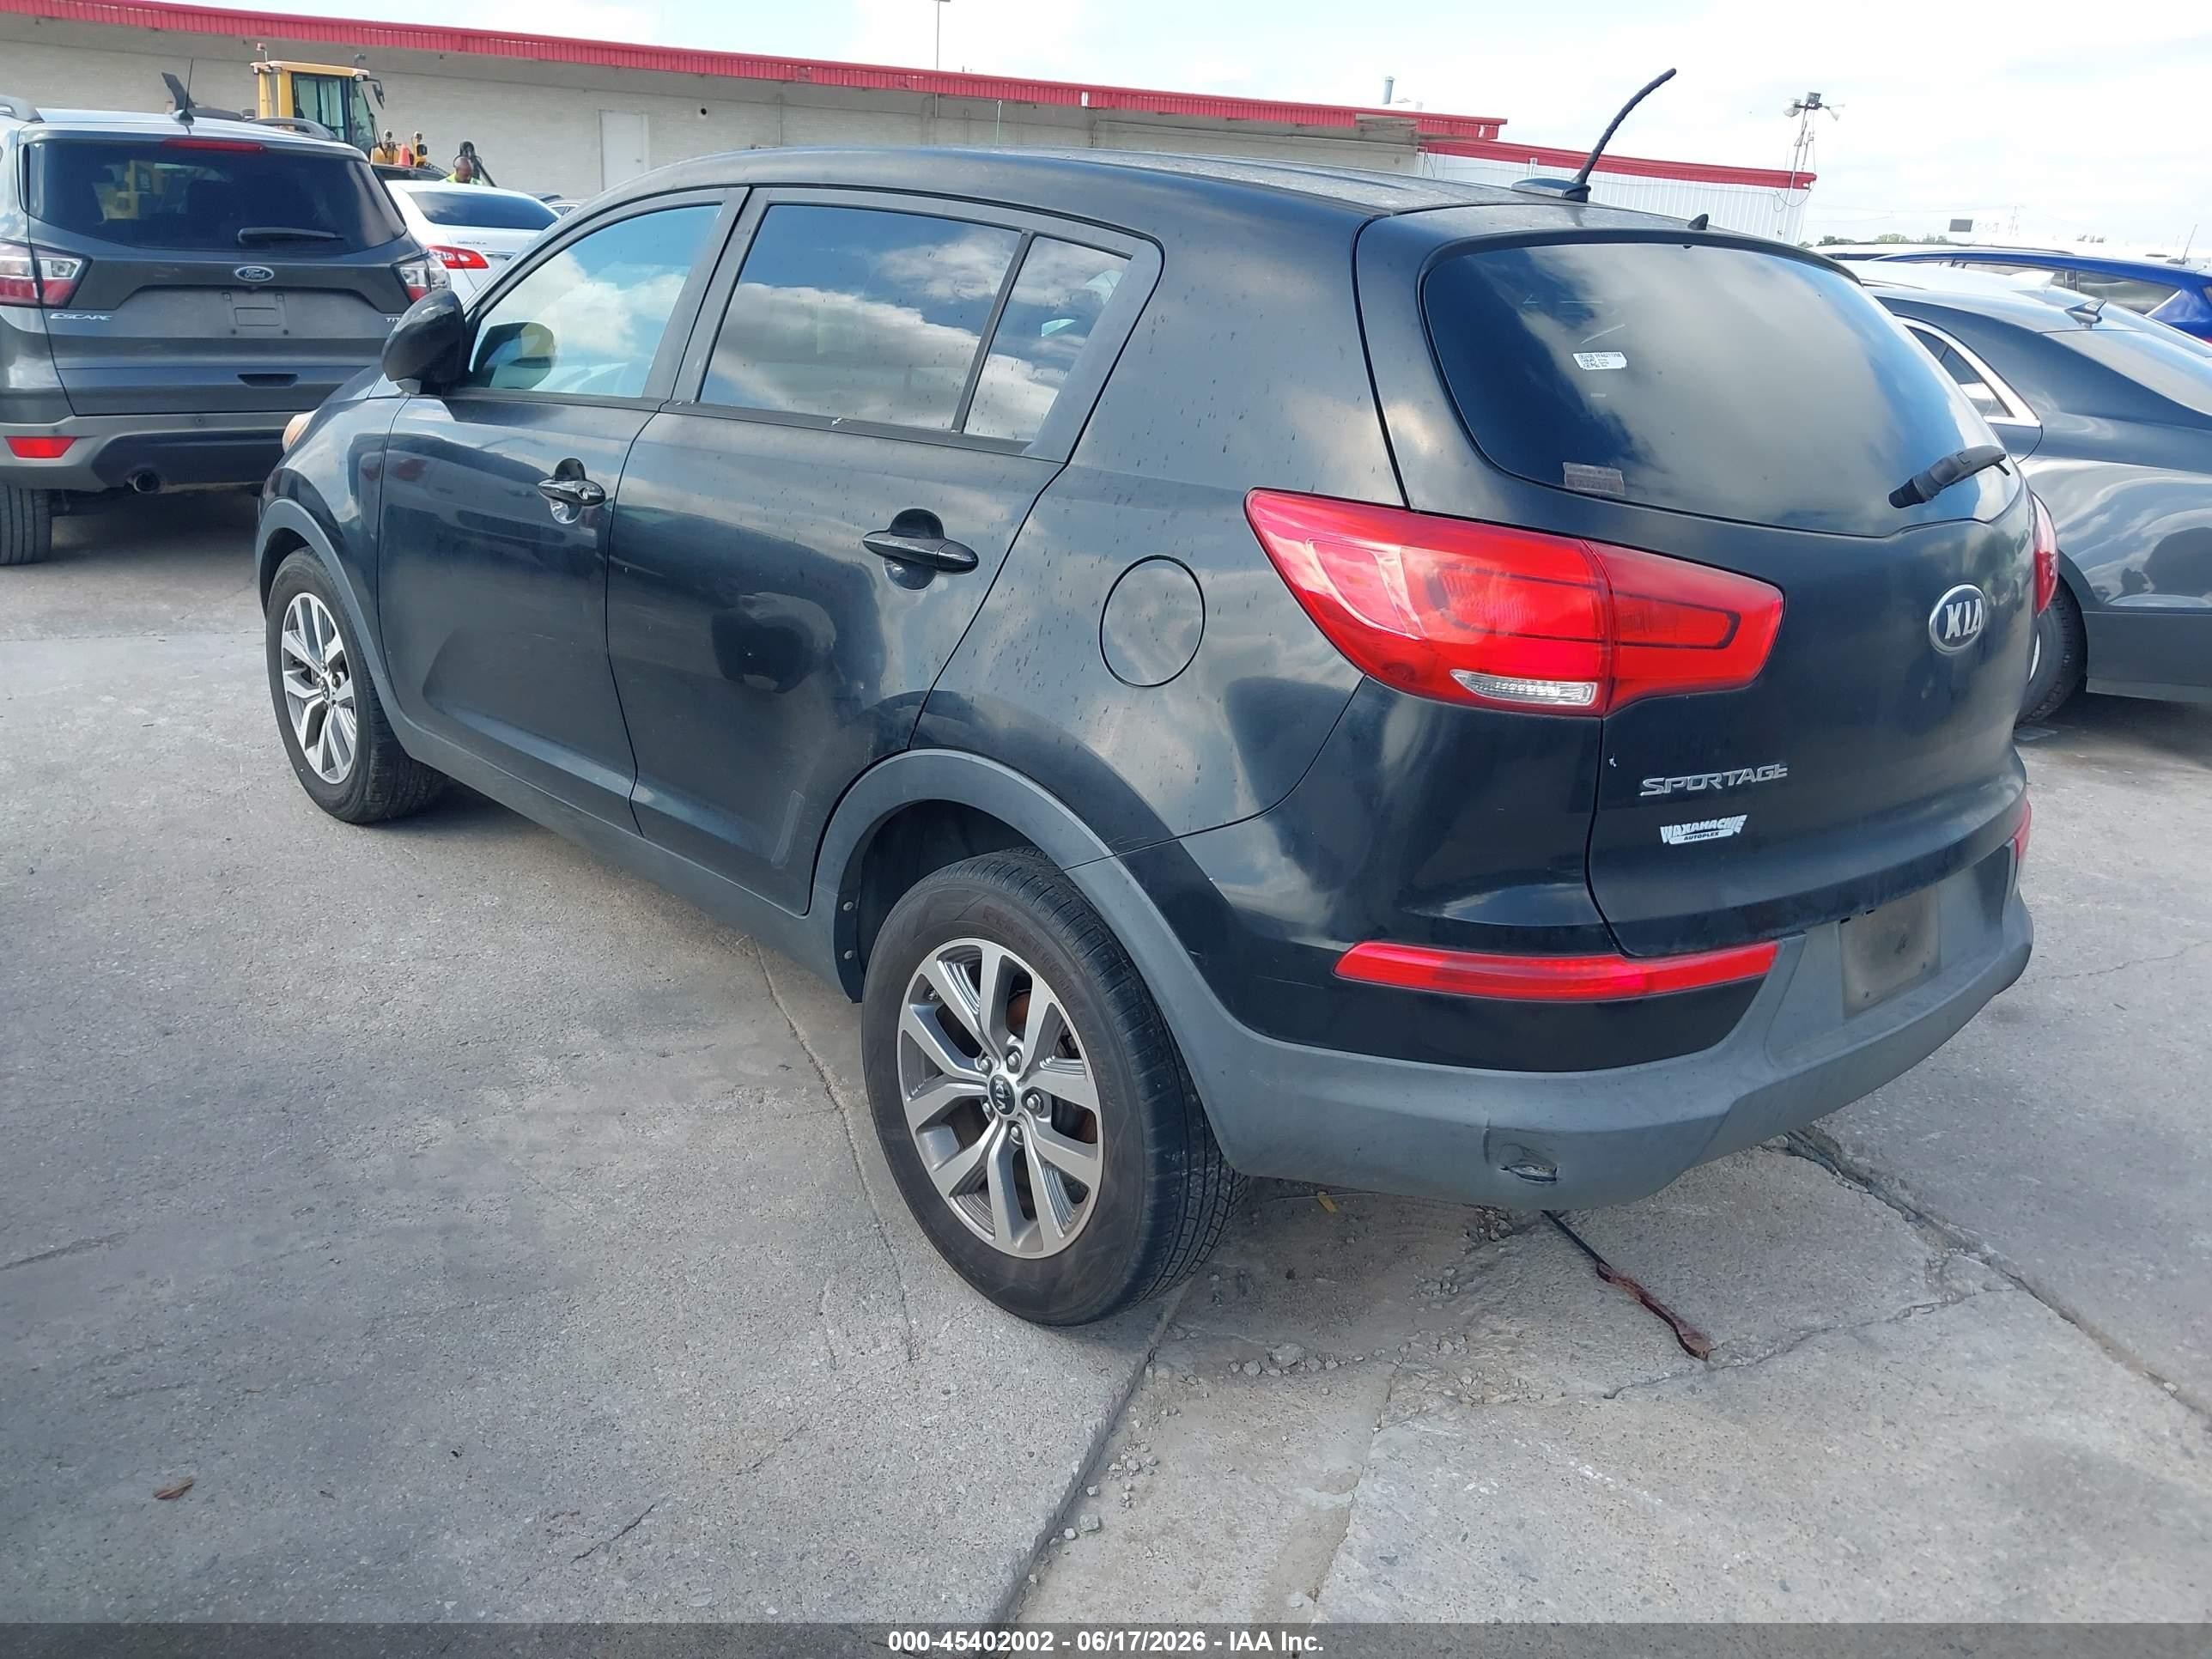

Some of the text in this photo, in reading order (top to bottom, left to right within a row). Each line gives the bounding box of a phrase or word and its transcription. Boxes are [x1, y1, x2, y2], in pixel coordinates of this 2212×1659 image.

[1944, 598, 1983, 640] KIA
[1640, 763, 1788, 796] SPORTAGE
[1683, 831, 1720, 842] AUTOPLEX
[994, 1078, 1006, 1110] KIA
